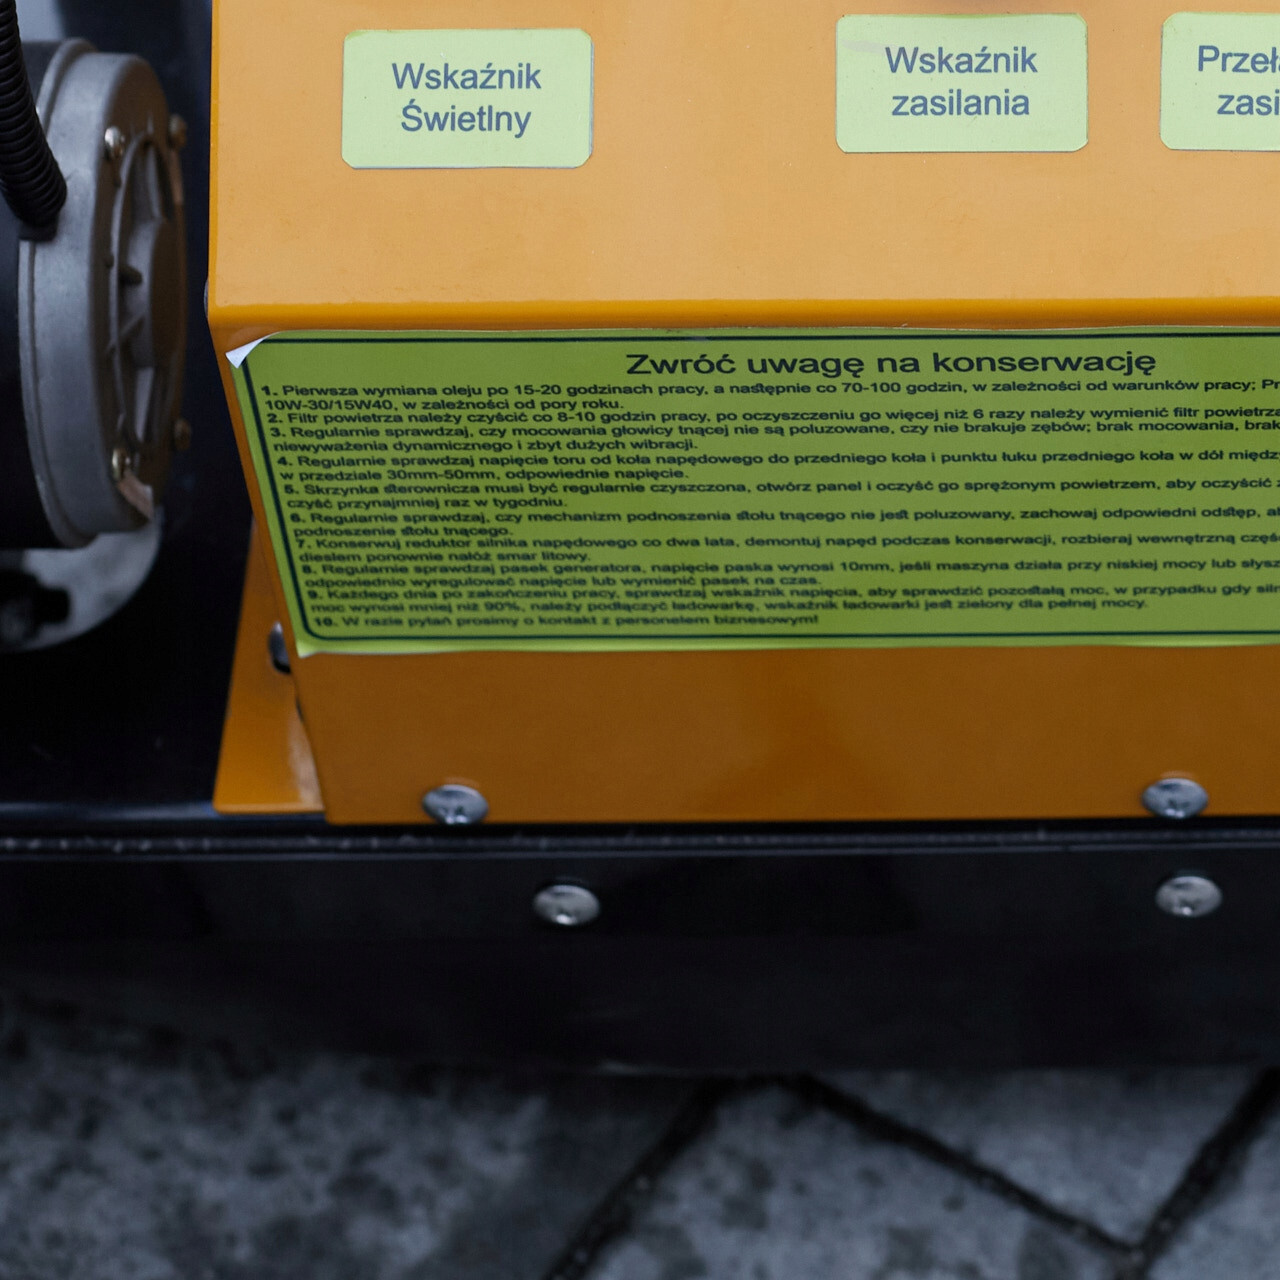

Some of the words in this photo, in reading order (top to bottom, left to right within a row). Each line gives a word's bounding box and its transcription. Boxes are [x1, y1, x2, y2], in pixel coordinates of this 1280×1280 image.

[884, 45, 1039, 74] Wskaźnik
[391, 62, 542, 90] Wskaźnik
[891, 88, 1030, 117] zasilania
[400, 98, 532, 139] Świetlny
[625, 353, 737, 375] Zwróć
[746, 357, 865, 379] uwagę
[876, 356, 921, 373] na
[932, 350, 1157, 377] konserwację
[281, 385, 359, 397] Pierwsza
[362, 384, 438, 399] wymiana
[441, 384, 483, 398] oleju
[486, 386, 509, 398] po
[513, 383, 562, 395] 15-20
[566, 383, 654, 397] godzinach
[713, 385, 725, 394] a
[815, 384, 838, 393] co
[841, 381, 902, 393] 70-100
[971, 383, 988, 392] w
[991, 380, 1082, 392] zależności
[1085, 380, 1108, 391] od
[1111, 379, 1200, 391] warunków
[286, 412, 319, 424] Filtr
[322, 412, 404, 426] powietrza
[407, 411, 463, 426] należy
[466, 411, 529, 425] czyścić
[532, 413, 554, 423] co
[557, 410, 596, 422] 8-10
[599, 410, 657, 424] godzin
[715, 412, 738, 424] po
[741, 409, 855, 423] oczyszczeniu
[859, 411, 882, 423] go
[884, 408, 940, 422] więcej
[943, 408, 969, 420] niż
[972, 408, 985, 419] 6
[988, 410, 1026, 422] razy
[1030, 407, 1086, 421] należy
[1089, 407, 1170, 421] wymienić
[1172, 406, 1201, 418] filtr
[401, 400, 417, 410] w
[421, 398, 510, 410] zależności
[513, 398, 536, 410] od
[539, 400, 578, 412] pory
[289, 426, 381, 440] Regularnie
[478, 428, 508, 439] czy
[511, 425, 608, 436] mocowania
[610, 424, 674, 438] głowicy
[677, 423, 730, 437] tnącej
[733, 423, 760, 435] nie
[763, 425, 786, 437] są
[899, 424, 930, 436] czy
[933, 421, 960, 433] nie
[963, 421, 1027, 435] brakuje
[1096, 420, 1134, 432] brak
[272, 440, 389, 454] niewyważenia
[392, 439, 514, 454] dynamicznego
[517, 439, 523, 451] i
[526, 439, 563, 453] zbyt
[565, 438, 626, 453] dużych
